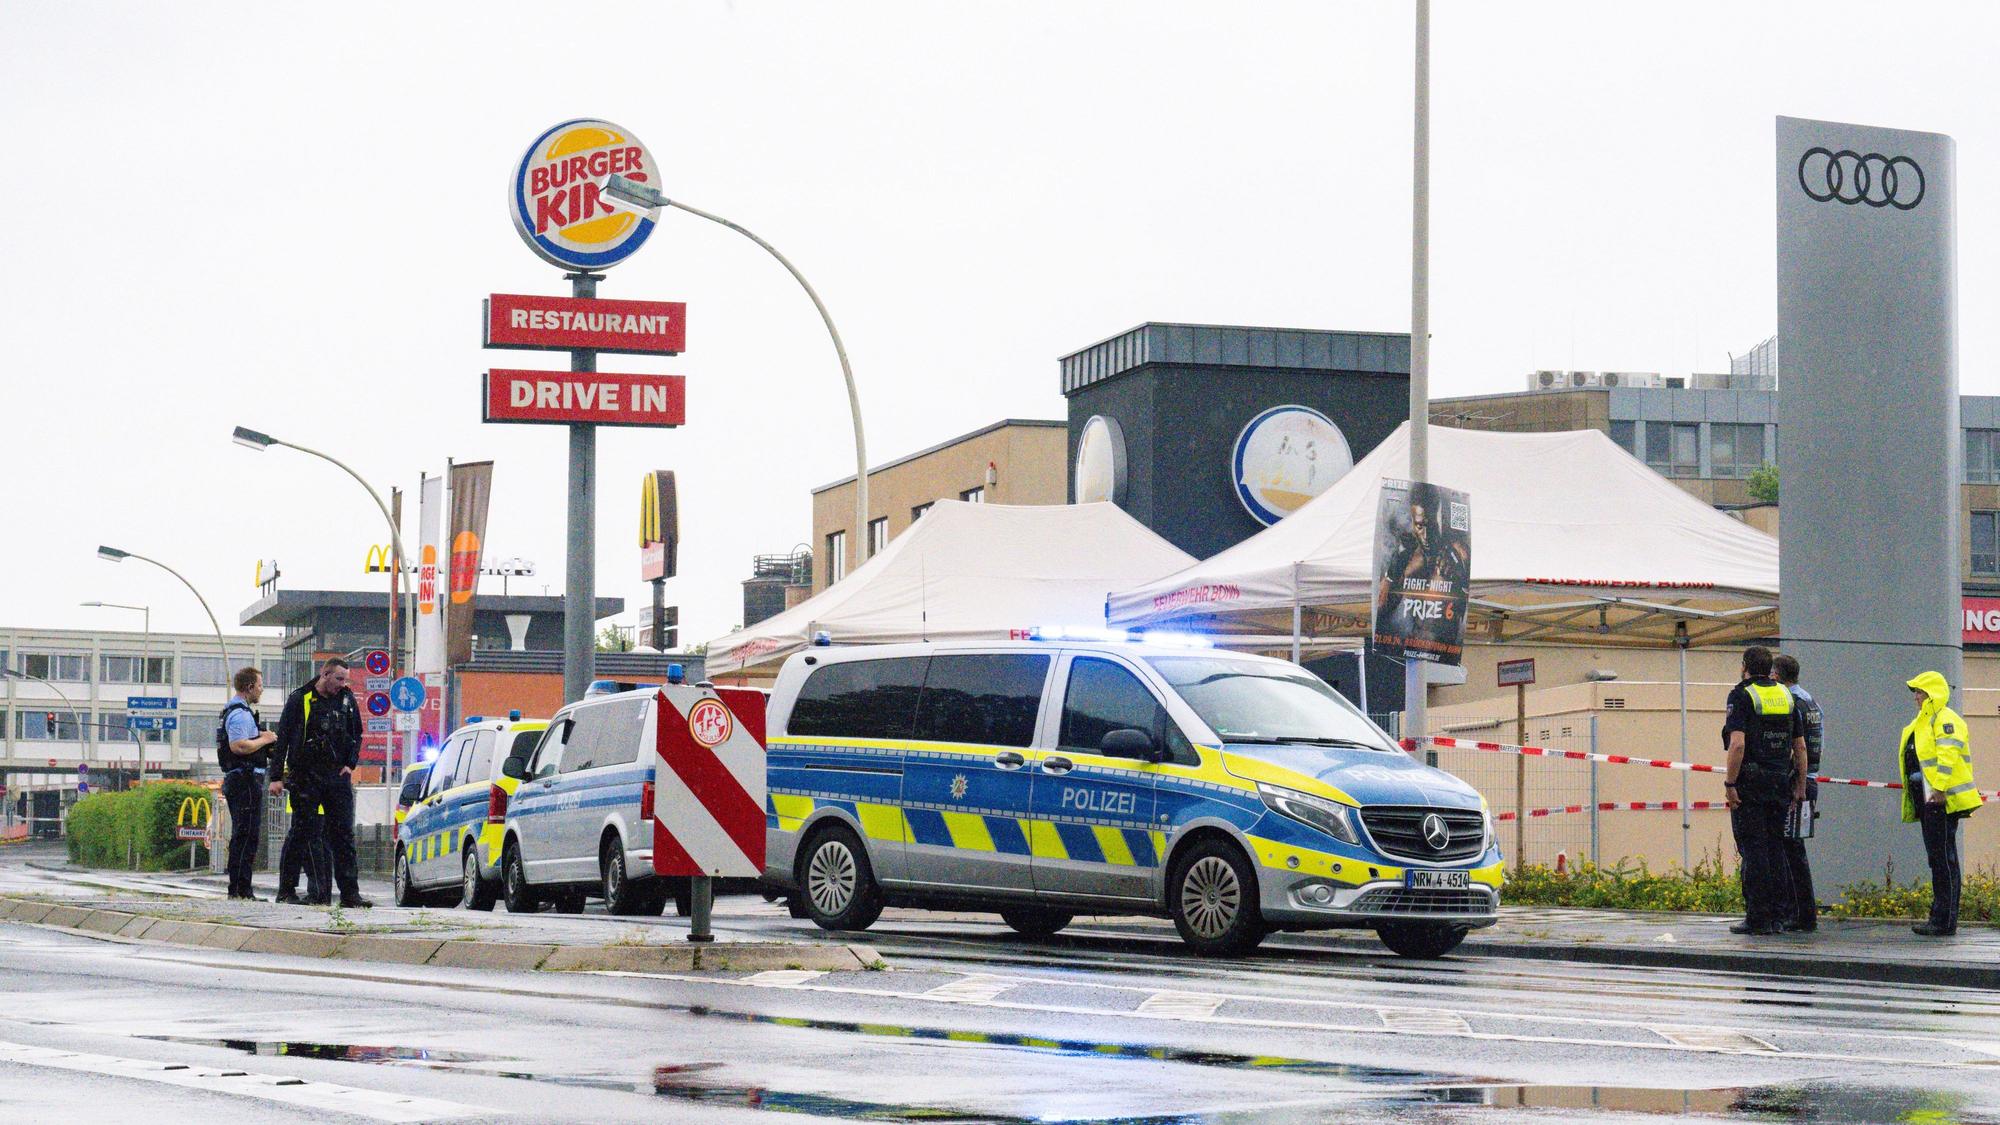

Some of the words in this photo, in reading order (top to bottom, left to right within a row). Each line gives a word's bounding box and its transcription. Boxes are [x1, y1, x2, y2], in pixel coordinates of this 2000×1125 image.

[531, 146, 643, 197] BURGER
[536, 171, 648, 236] KIN
[511, 309, 669, 335] RESTAURANT
[510, 380, 619, 410] DRIVE
[631, 382, 667, 413] IN
[1153, 585, 1209, 610] FEUERWEHR
[1211, 584, 1240, 601] BONN
[1403, 578, 1453, 593] FIGHT-NIGHT
[1403, 598, 1442, 620] PRIZE
[1445, 601, 1454, 620] 6
[1061, 787, 1136, 814] POLIZEI
[1413, 874, 1432, 887] NRW
[1436, 874, 1468, 889] 4-4514
